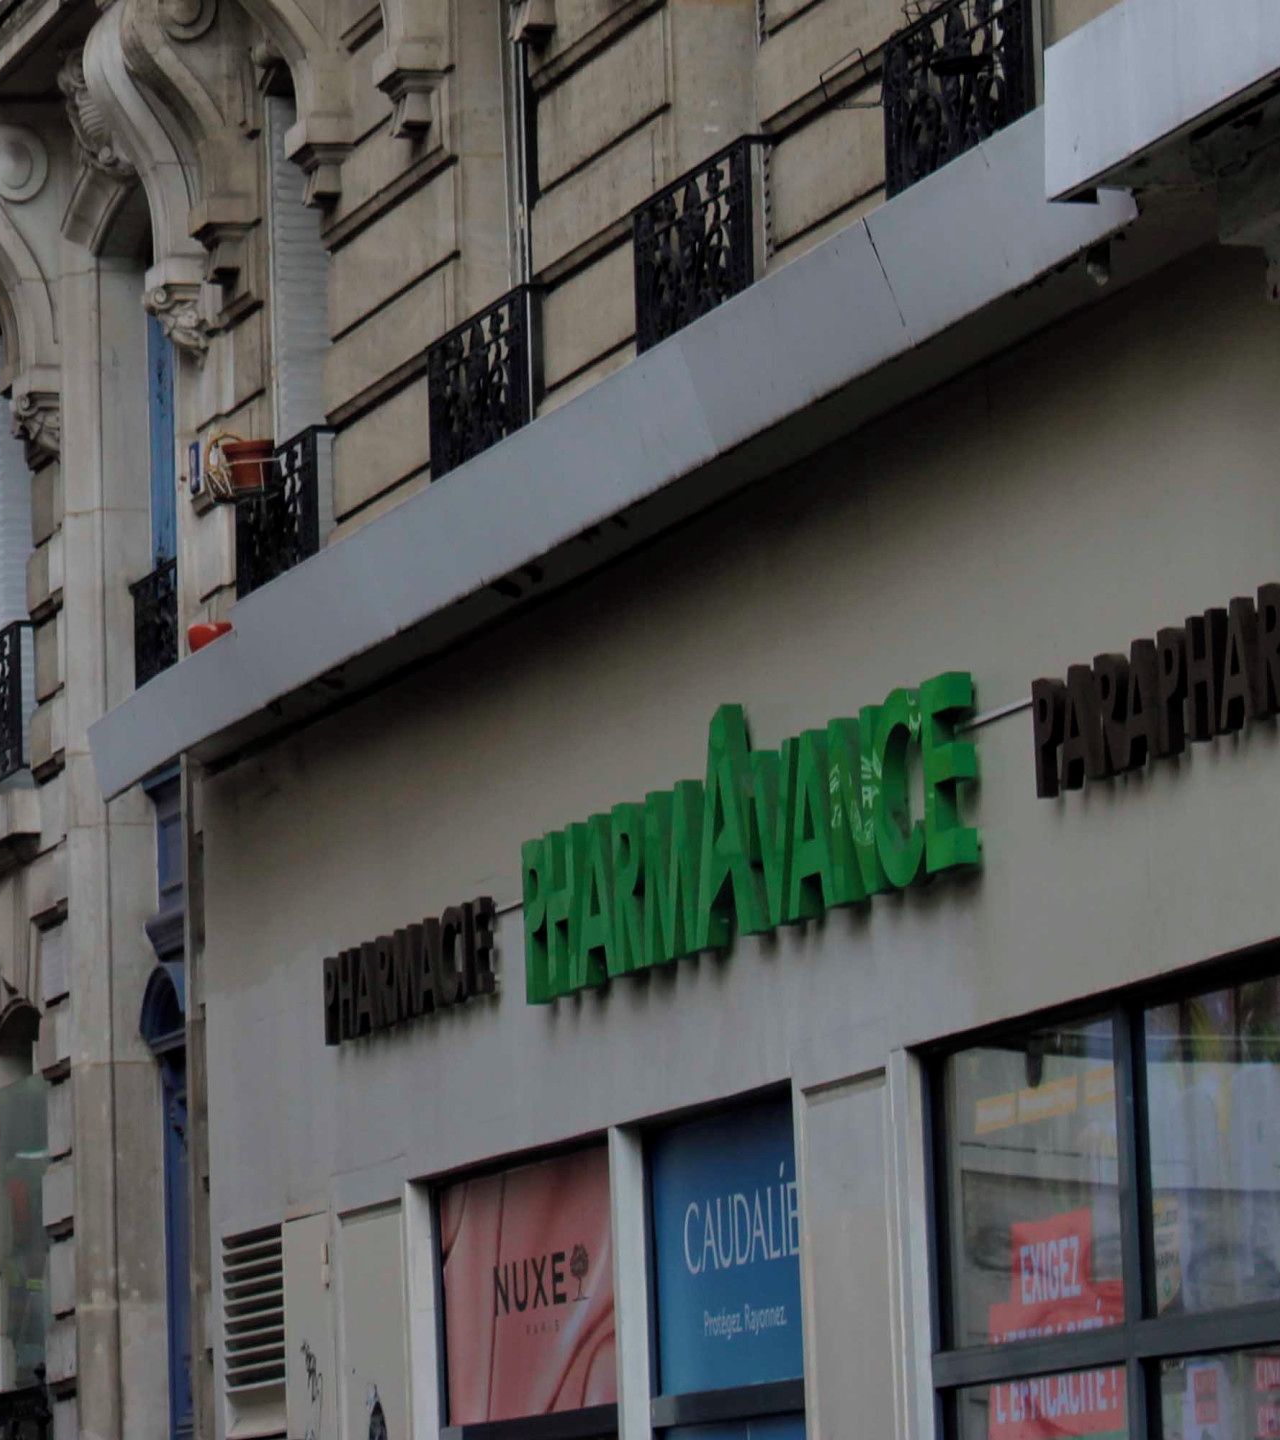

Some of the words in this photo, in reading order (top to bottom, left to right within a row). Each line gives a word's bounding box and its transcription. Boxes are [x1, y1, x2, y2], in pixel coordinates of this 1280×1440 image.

[521, 671, 982, 1005] PHARMAVANCE
[324, 896, 499, 1046] PHARMACIE
[493, 1251, 567, 1317] NUXE
[1019, 1234, 1082, 1305] EXIGEZ
